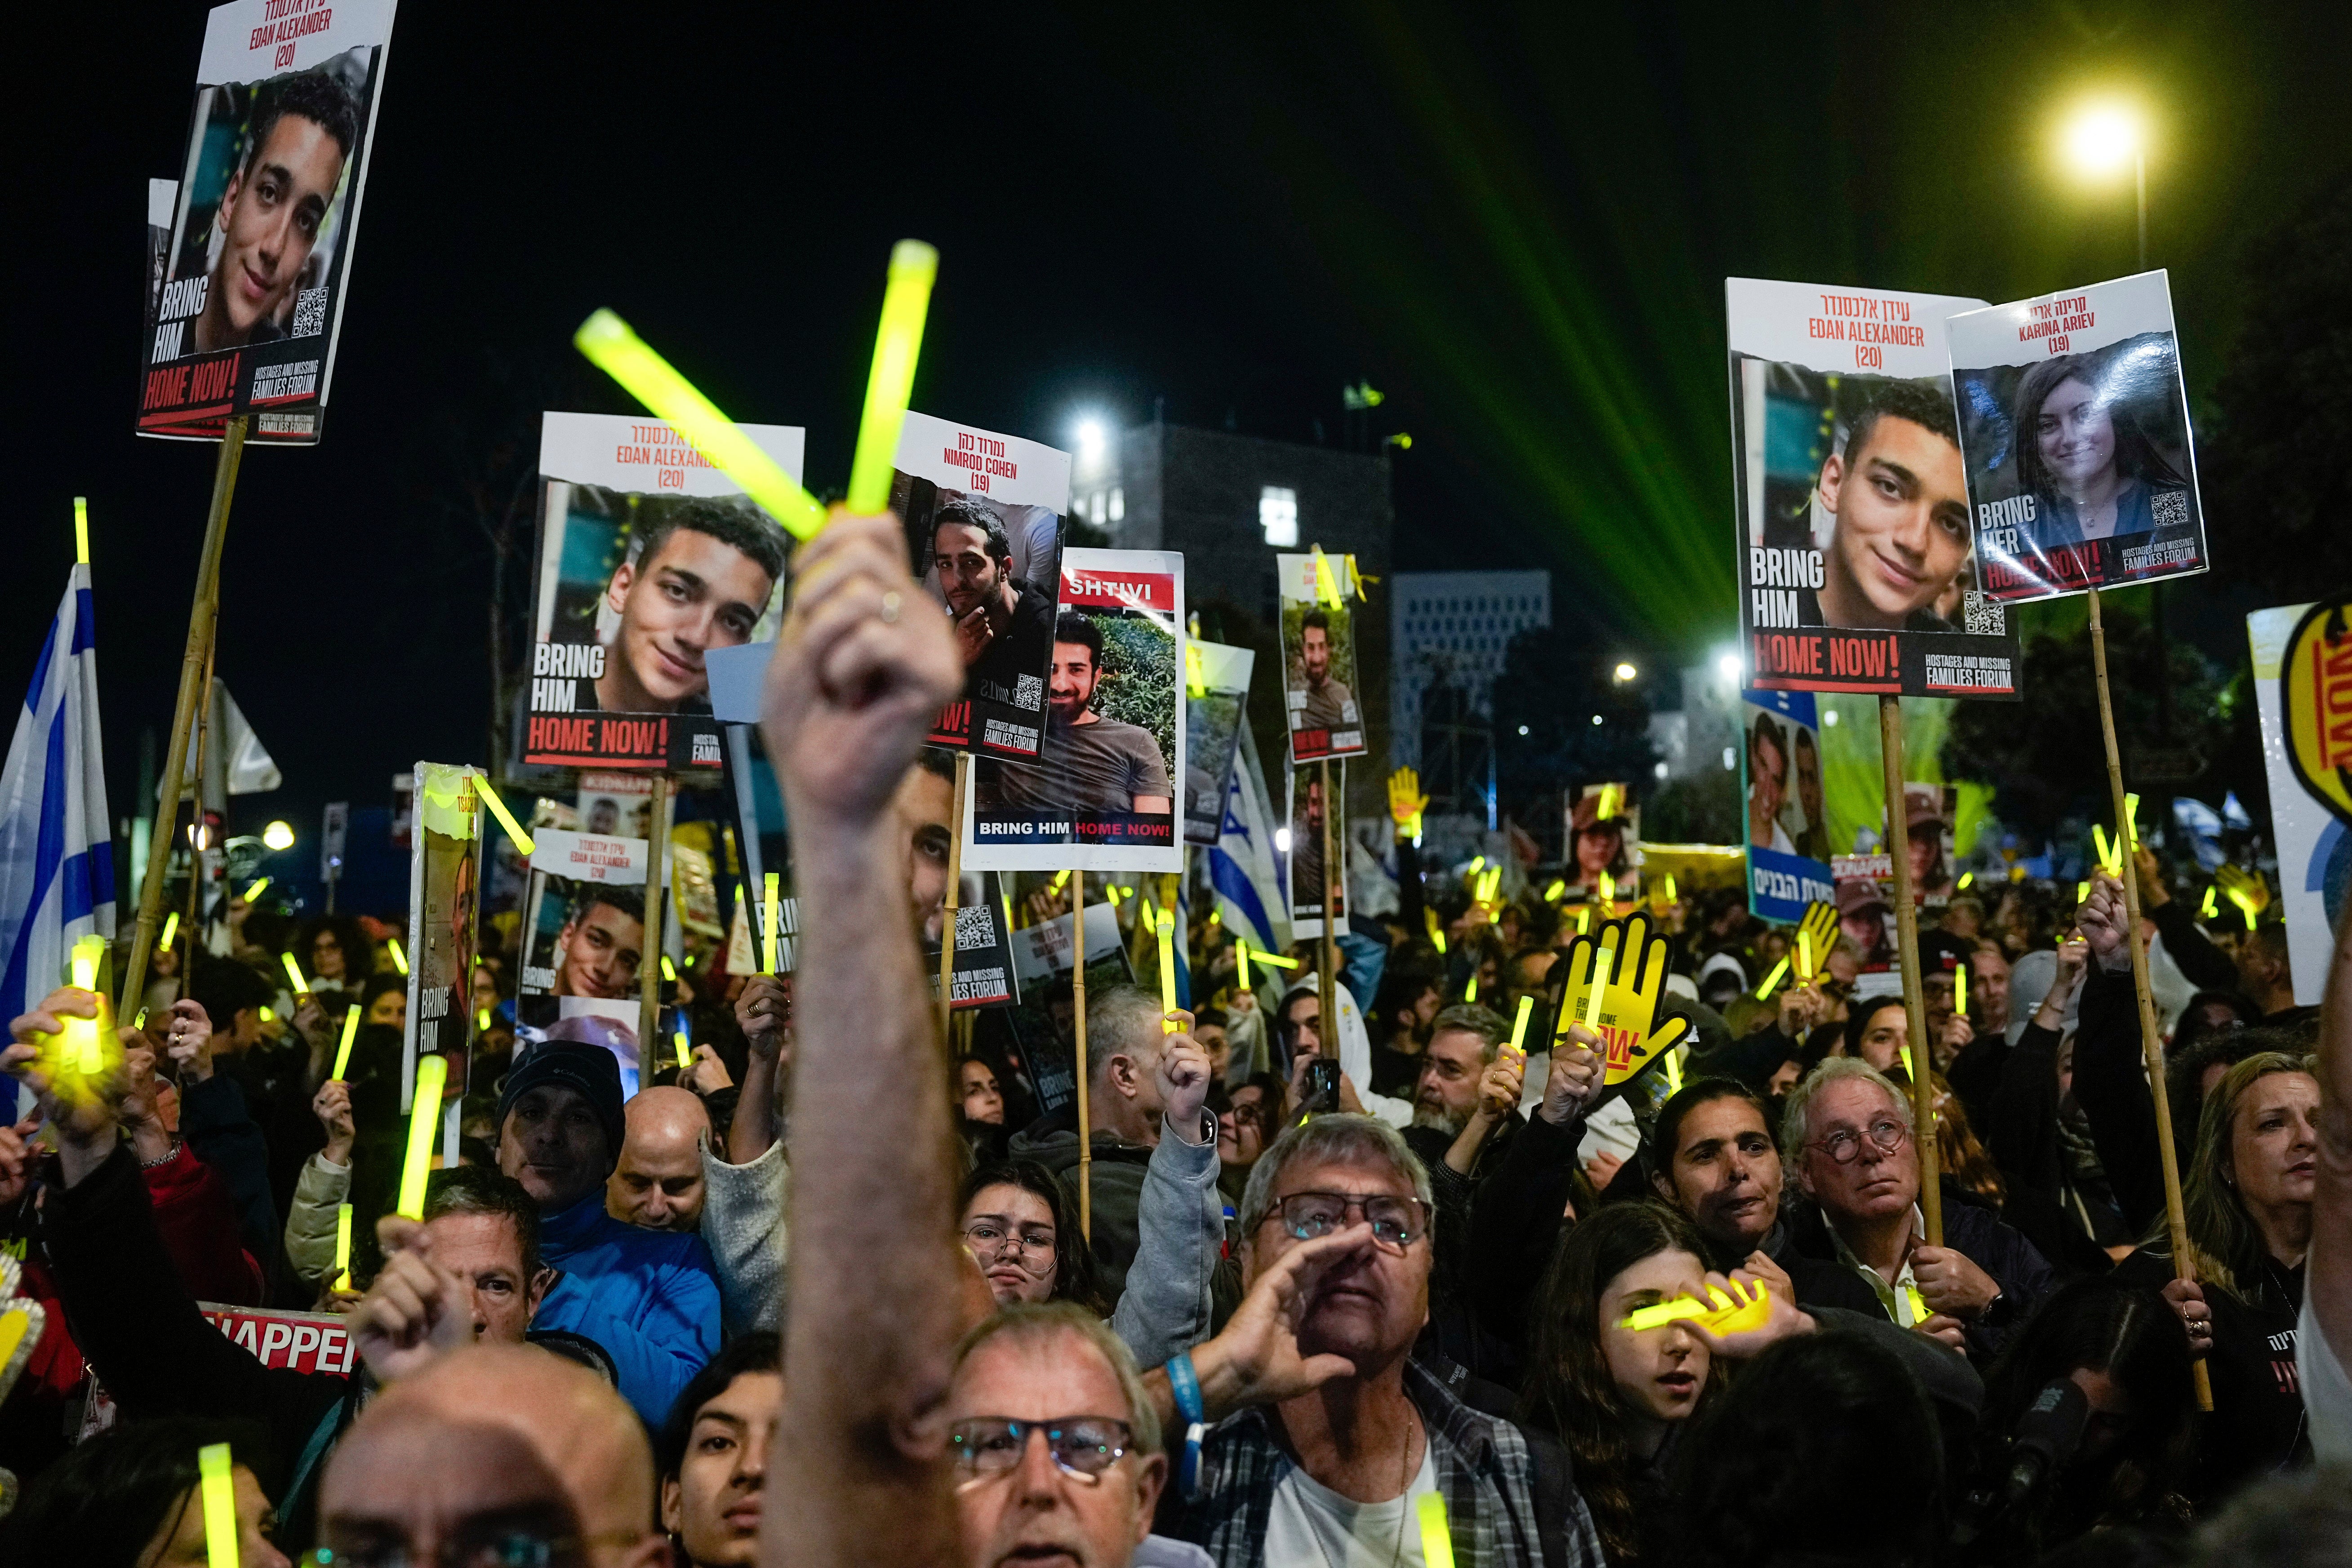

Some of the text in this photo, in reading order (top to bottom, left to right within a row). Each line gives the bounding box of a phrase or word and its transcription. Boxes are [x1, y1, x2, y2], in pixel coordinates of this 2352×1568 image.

[249, 9, 332, 50] EDAN ALEXANDER
[275, 41, 295, 71] (20)
[159, 275, 208, 321] BRING
[1820, 295, 1910, 322] עידן אלכסנדר
[2054, 297, 2085, 316] קרינה
[1809, 318, 1924, 346] EDAN ALEXANDER
[2019, 312, 2094, 342] KARINA ARIEV
[151, 321, 184, 364] HIM
[2049, 334, 2069, 355] (19)
[255, 360, 319, 380] HOSTAGES AND MISSING
[1855, 345, 1882, 369] (20)
[143, 352, 240, 410] HOME NOW!
[252, 374, 316, 400] FAMILIES FORUM
[259, 421, 314, 433] FAMILIES FORUM
[617, 446, 650, 464] EDAN
[959, 432, 1005, 458] נמרוד כהן
[944, 448, 1017, 480] NIMROD COHEN
[659, 468, 684, 489] (20)
[971, 472, 989, 493] (19)
[1978, 495, 2036, 530] BRING
[1982, 528, 2020, 558] HER
[2122, 537, 2194, 558] HOSTAGES AND MISSING
[1750, 547, 1824, 589] BRING
[2046, 542, 2101, 579] NOW!
[2123, 546, 2196, 571] FAMILIES FORUM
[1069, 579, 1151, 600] SHTIVI
[1752, 588, 1798, 629] HIM
[534, 643, 605, 679] BRING
[1754, 634, 1900, 678] HOME NOW!
[1925, 654, 2010, 671] HOSTAGES AND MISSING
[1926, 667, 2012, 688] FAMILIES FORUM
[531, 679, 576, 713] HIM
[529, 717, 667, 755] HOME NOW!
[984, 728, 1037, 752] FAMILIES FORUM
[986, 719, 1038, 738] HOSTAGES AND MISSING
[980, 822, 1169, 836] BRING HIM HOME NOW!
[958, 970, 973, 983] AND
[973, 967, 1004, 981] MISSING
[970, 979, 1007, 999] FORUM
[422, 986, 449, 1020] BRING
[420, 1021, 438, 1053] HIM
